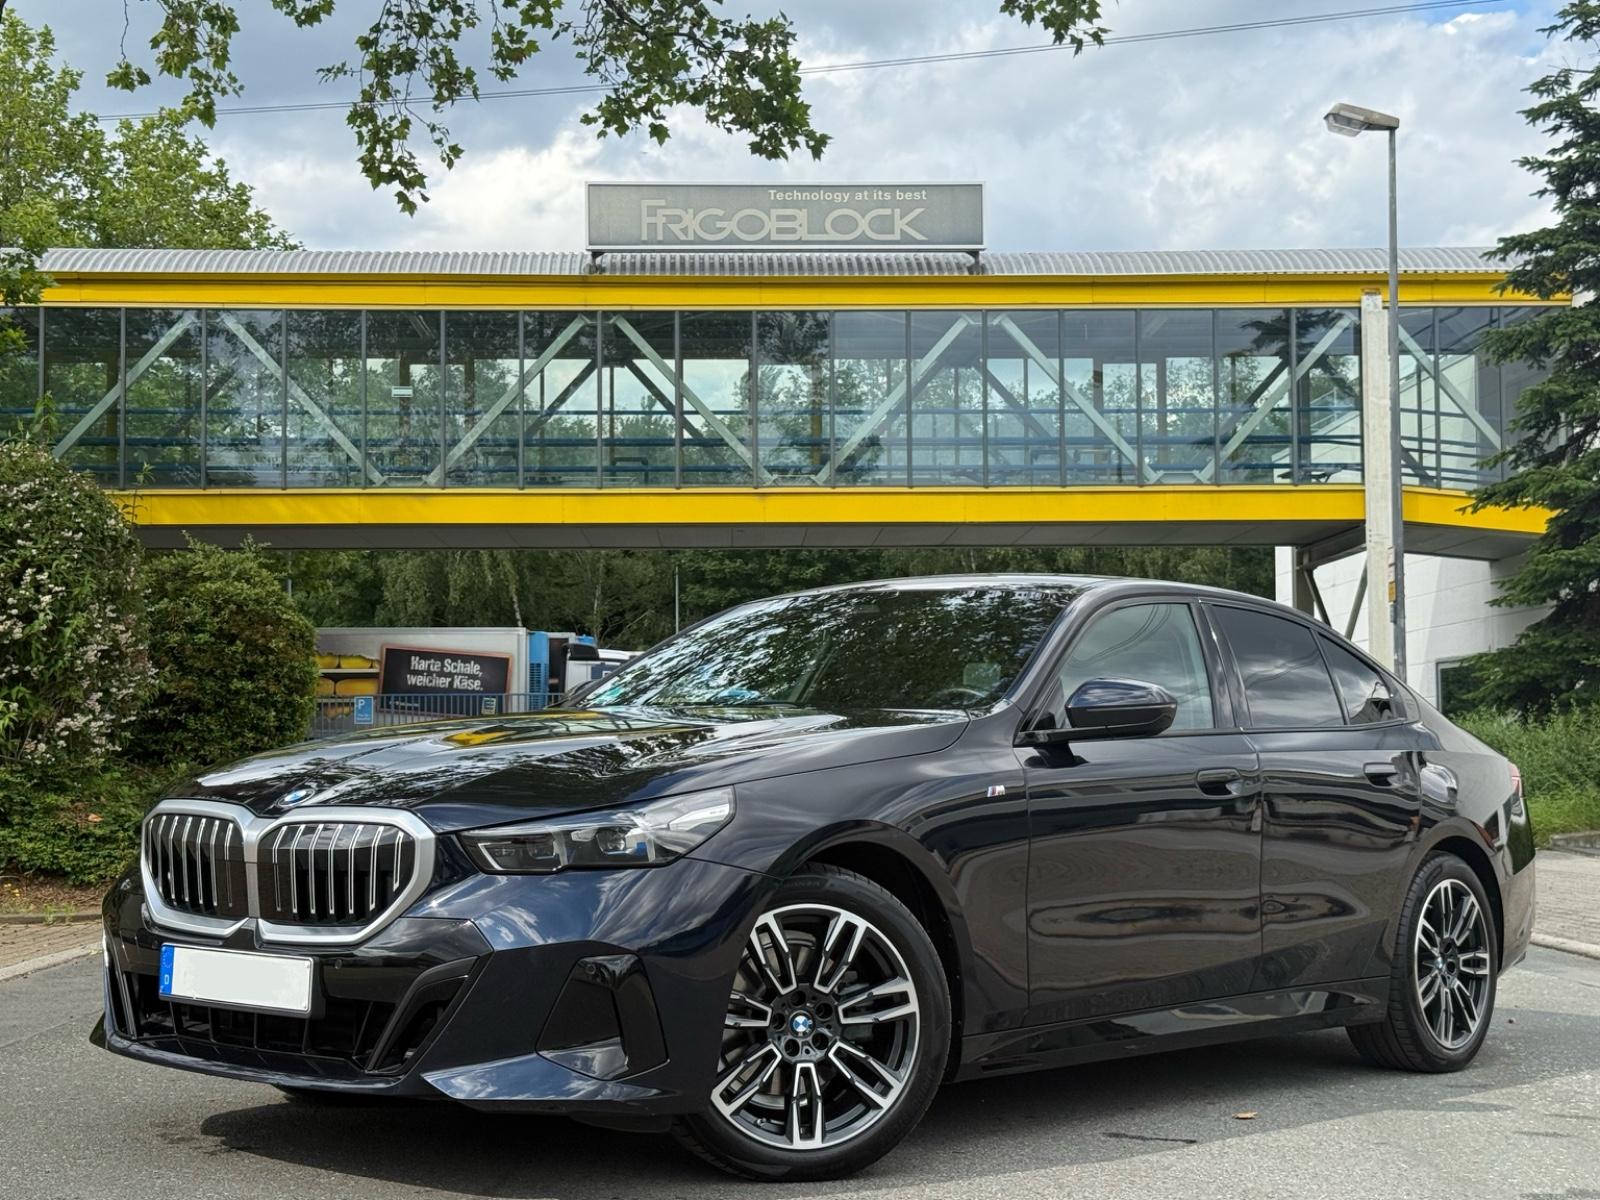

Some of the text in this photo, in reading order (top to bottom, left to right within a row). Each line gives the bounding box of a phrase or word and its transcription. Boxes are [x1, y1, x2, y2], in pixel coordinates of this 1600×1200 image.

[768, 189, 927, 203] Technology at its best
[410, 655, 483, 677] Harte Schale,
[406, 672, 484, 691] weicher Käse.
[358, 699, 366, 710] P
